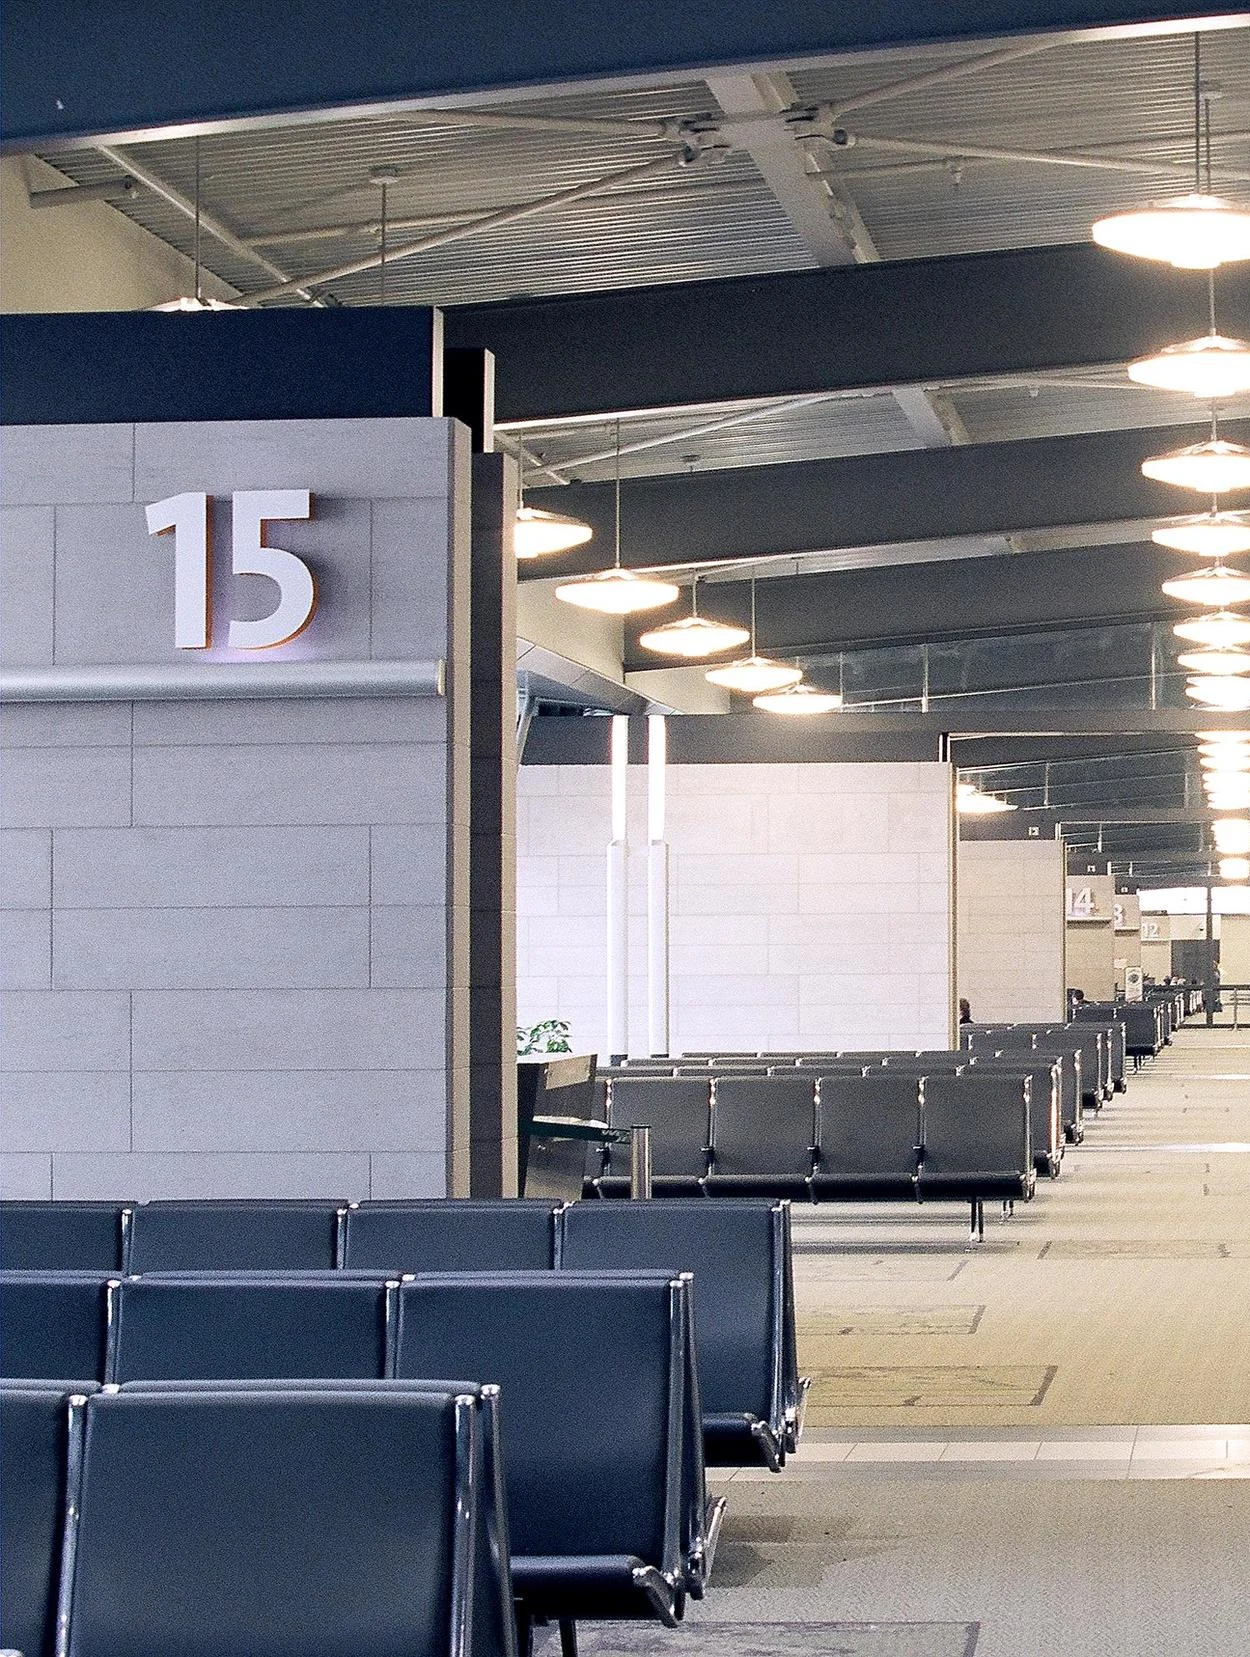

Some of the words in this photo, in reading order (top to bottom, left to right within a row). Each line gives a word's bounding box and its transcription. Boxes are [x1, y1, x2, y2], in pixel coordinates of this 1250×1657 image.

[145, 489, 316, 649] 15
[1066, 888, 1094, 914] 14
[1141, 923, 1159, 937] 12
